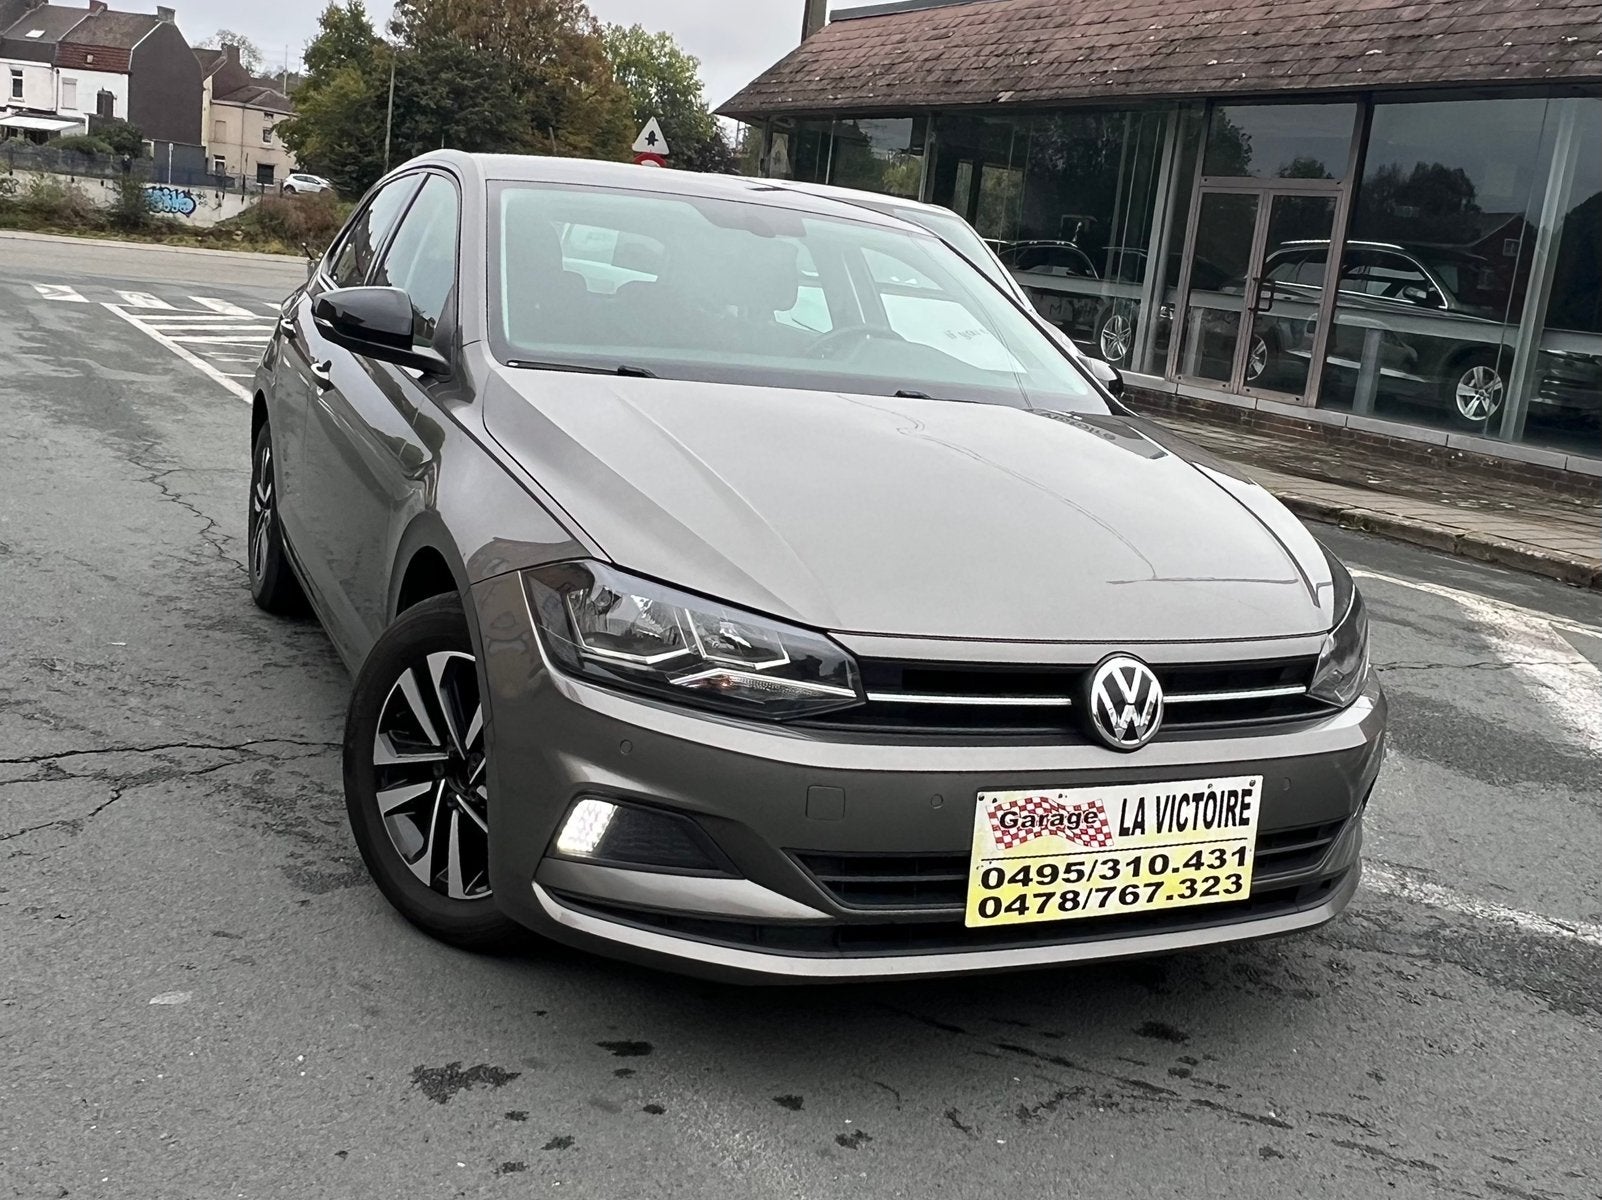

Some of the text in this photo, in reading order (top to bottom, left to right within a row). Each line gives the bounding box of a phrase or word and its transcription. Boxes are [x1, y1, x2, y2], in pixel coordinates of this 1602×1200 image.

[999, 810, 1099, 831] Garage
[1118, 788, 1253, 837] LA VICTOIRE
[980, 846, 1247, 890] 0495/310.431
[977, 873, 1244, 919] 0478/767.323
